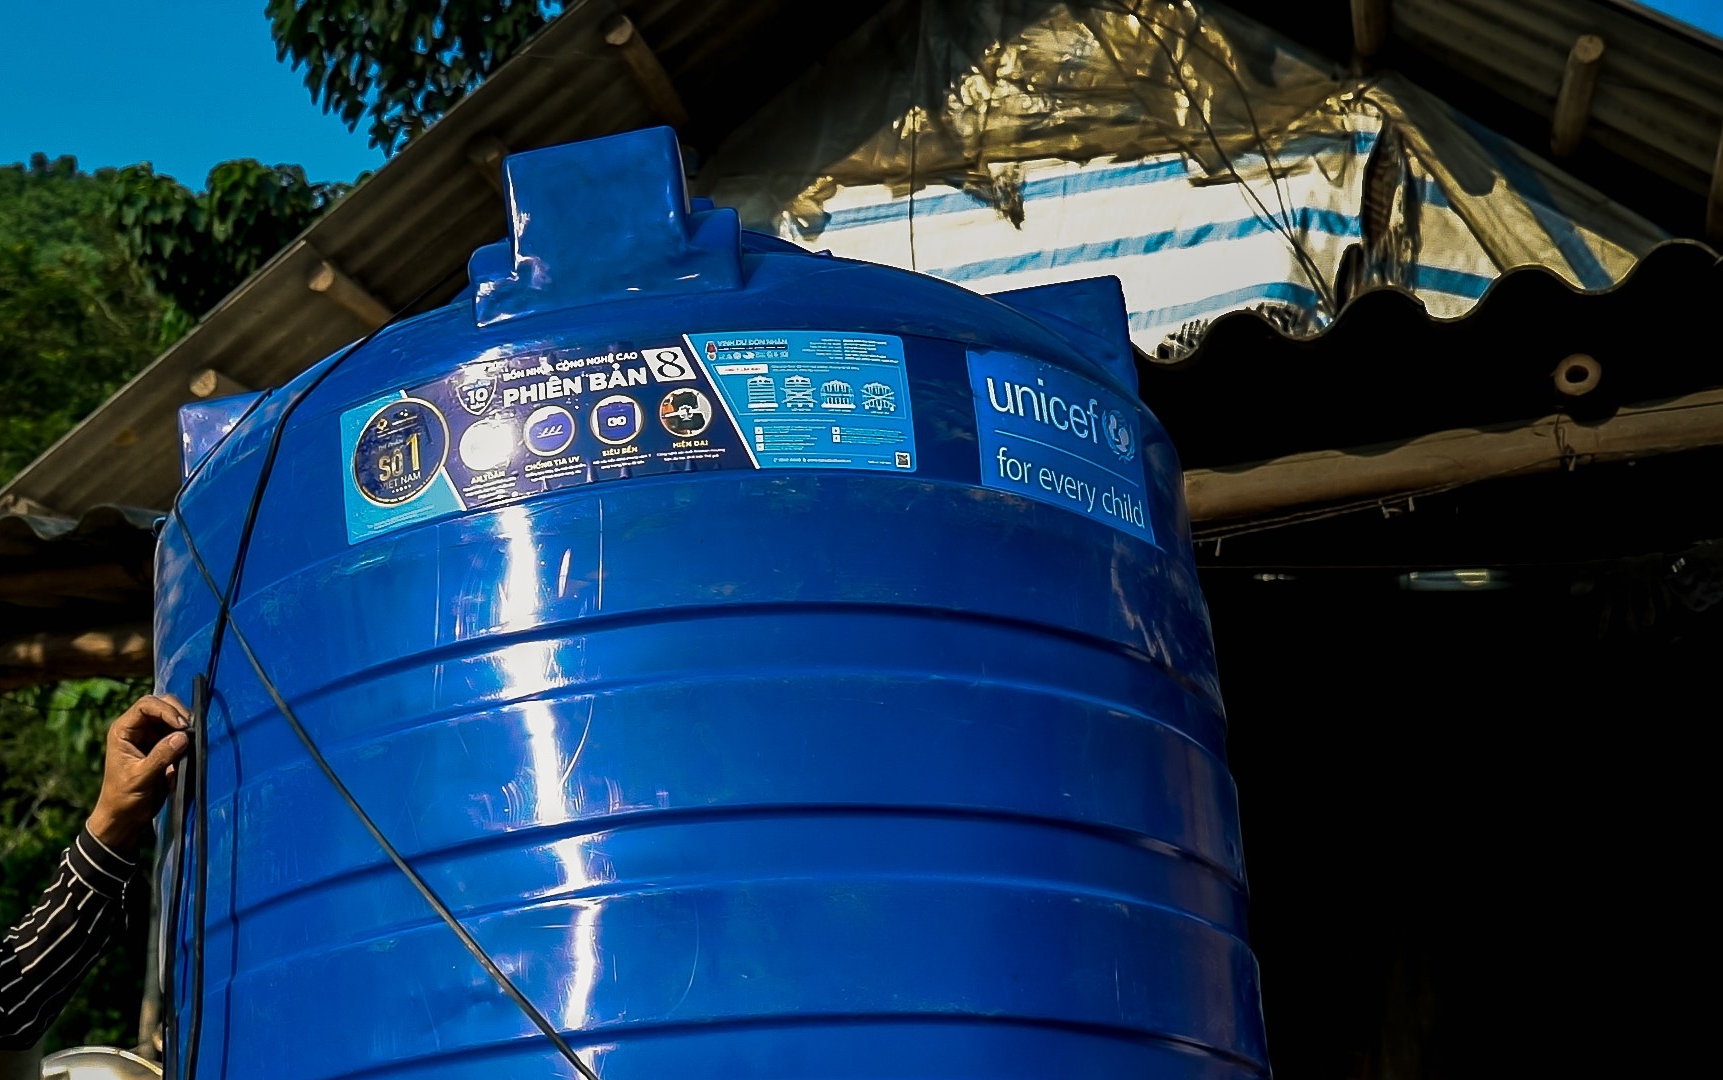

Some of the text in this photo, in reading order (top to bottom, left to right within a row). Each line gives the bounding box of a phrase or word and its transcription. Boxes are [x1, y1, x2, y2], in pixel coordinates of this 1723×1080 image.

[503, 375, 582, 407] PHIÊN
[589, 363, 647, 391] BẢN
[656, 351, 686, 379] 8
[616, 351, 638, 361] CAO
[467, 387, 489, 404] 10
[987, 377, 1098, 444] unicef
[405, 432, 421, 471] 1
[997, 446, 1145, 529] for every child
